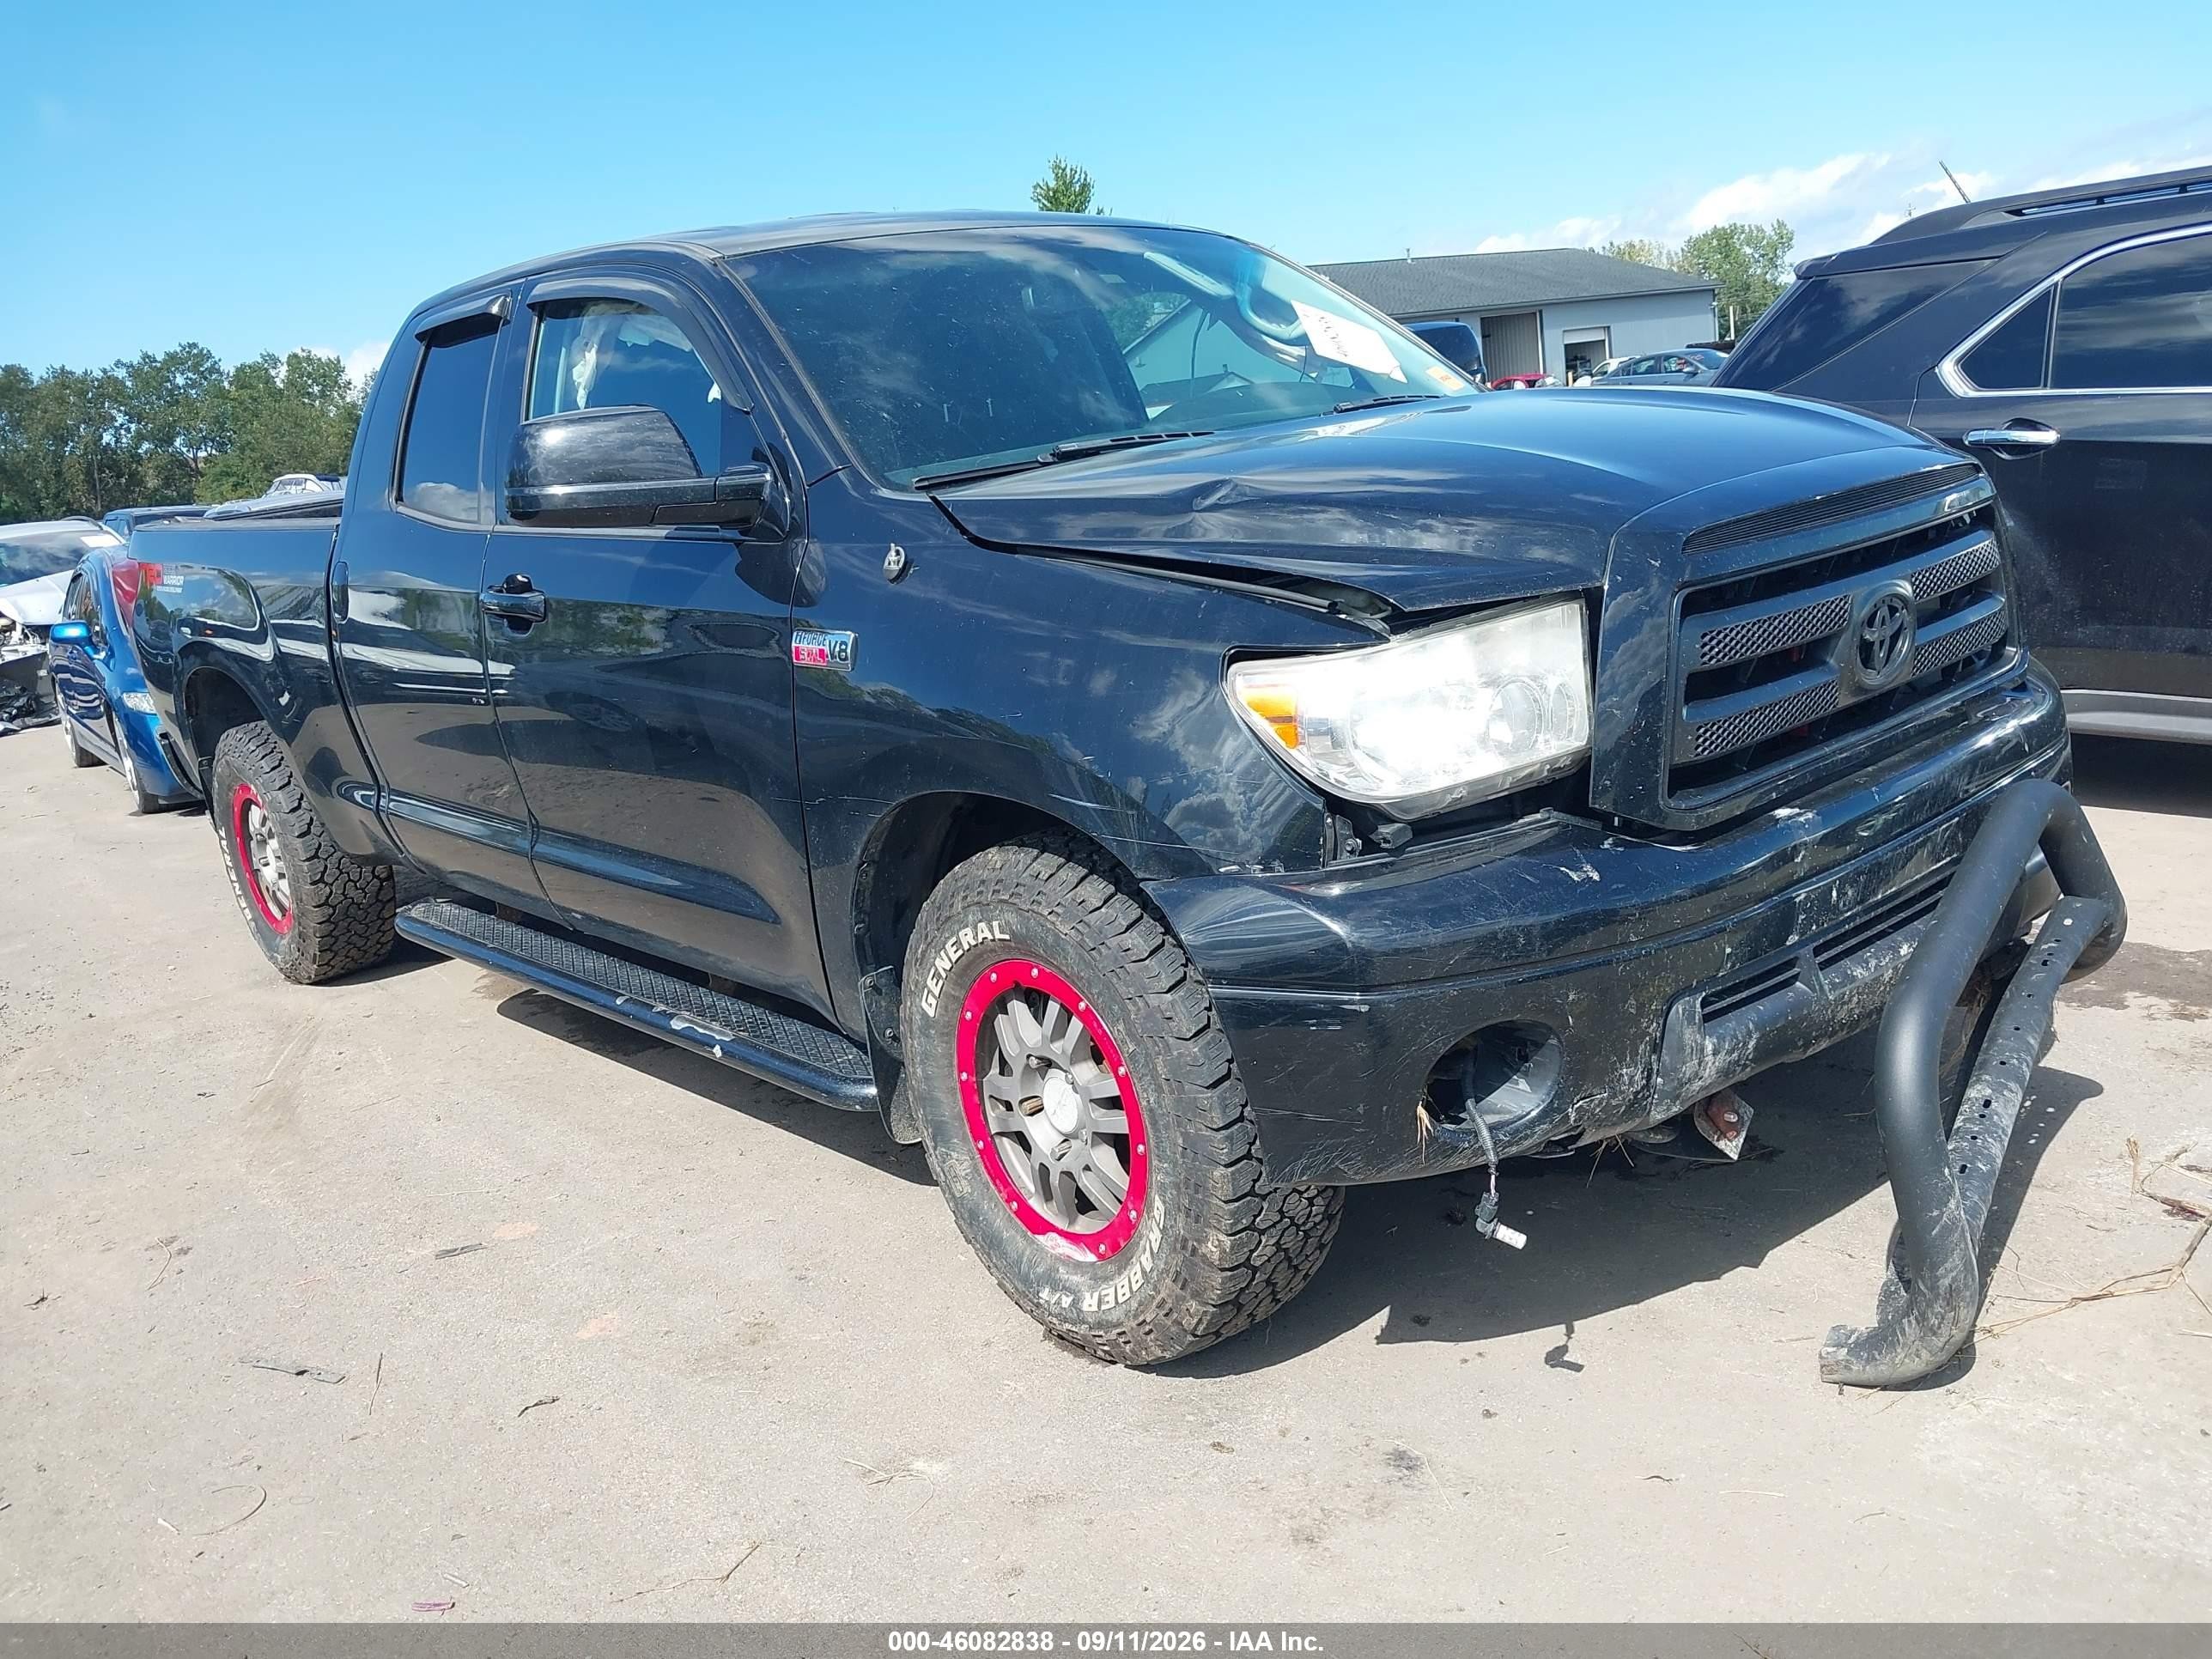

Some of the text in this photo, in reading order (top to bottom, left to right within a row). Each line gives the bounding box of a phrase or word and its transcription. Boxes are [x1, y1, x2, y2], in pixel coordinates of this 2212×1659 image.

[828, 639, 849, 662] V8
[219, 826, 252, 921] GENERAL
[921, 921, 1011, 1018] GENERAL
[1082, 1194, 1165, 1312] GRABBER
